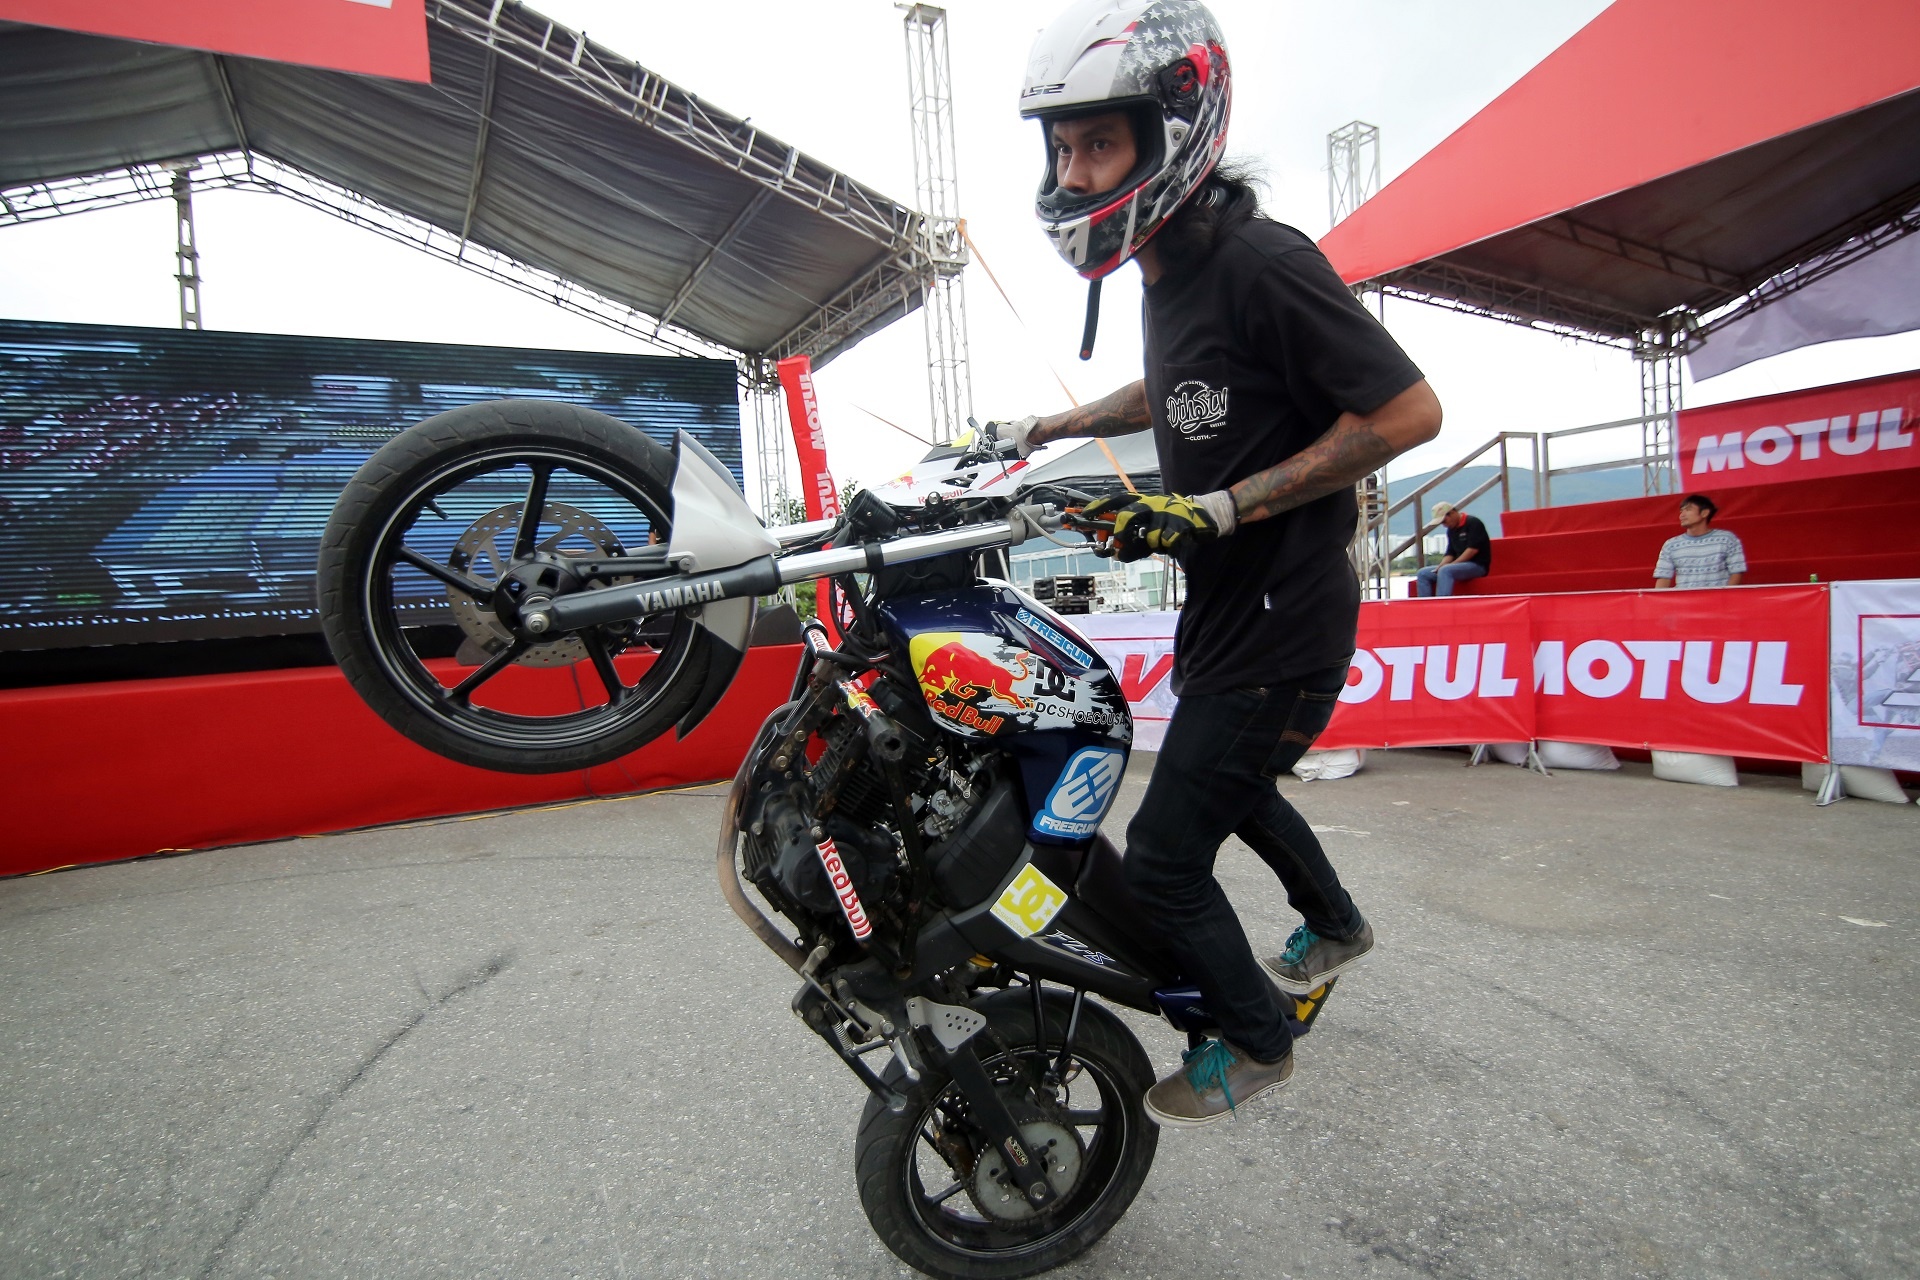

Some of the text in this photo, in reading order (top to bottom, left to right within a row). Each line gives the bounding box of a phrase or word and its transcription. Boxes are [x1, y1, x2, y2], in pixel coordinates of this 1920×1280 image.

[1021, 83, 1066, 99] LS2
[799, 370, 826, 450] MOTUL
[1691, 407, 1914, 475] MOTUL
[816, 468, 837, 520] OTUL
[637, 580, 726, 612] YAMAHA
[1029, 616, 1092, 668] FREEGUN
[1337, 643, 1519, 704] OTUL
[923, 688, 1005, 735] Red Bull
[1040, 815, 1097, 834] FREEGUN
[818, 838, 873, 937] Red Bull
